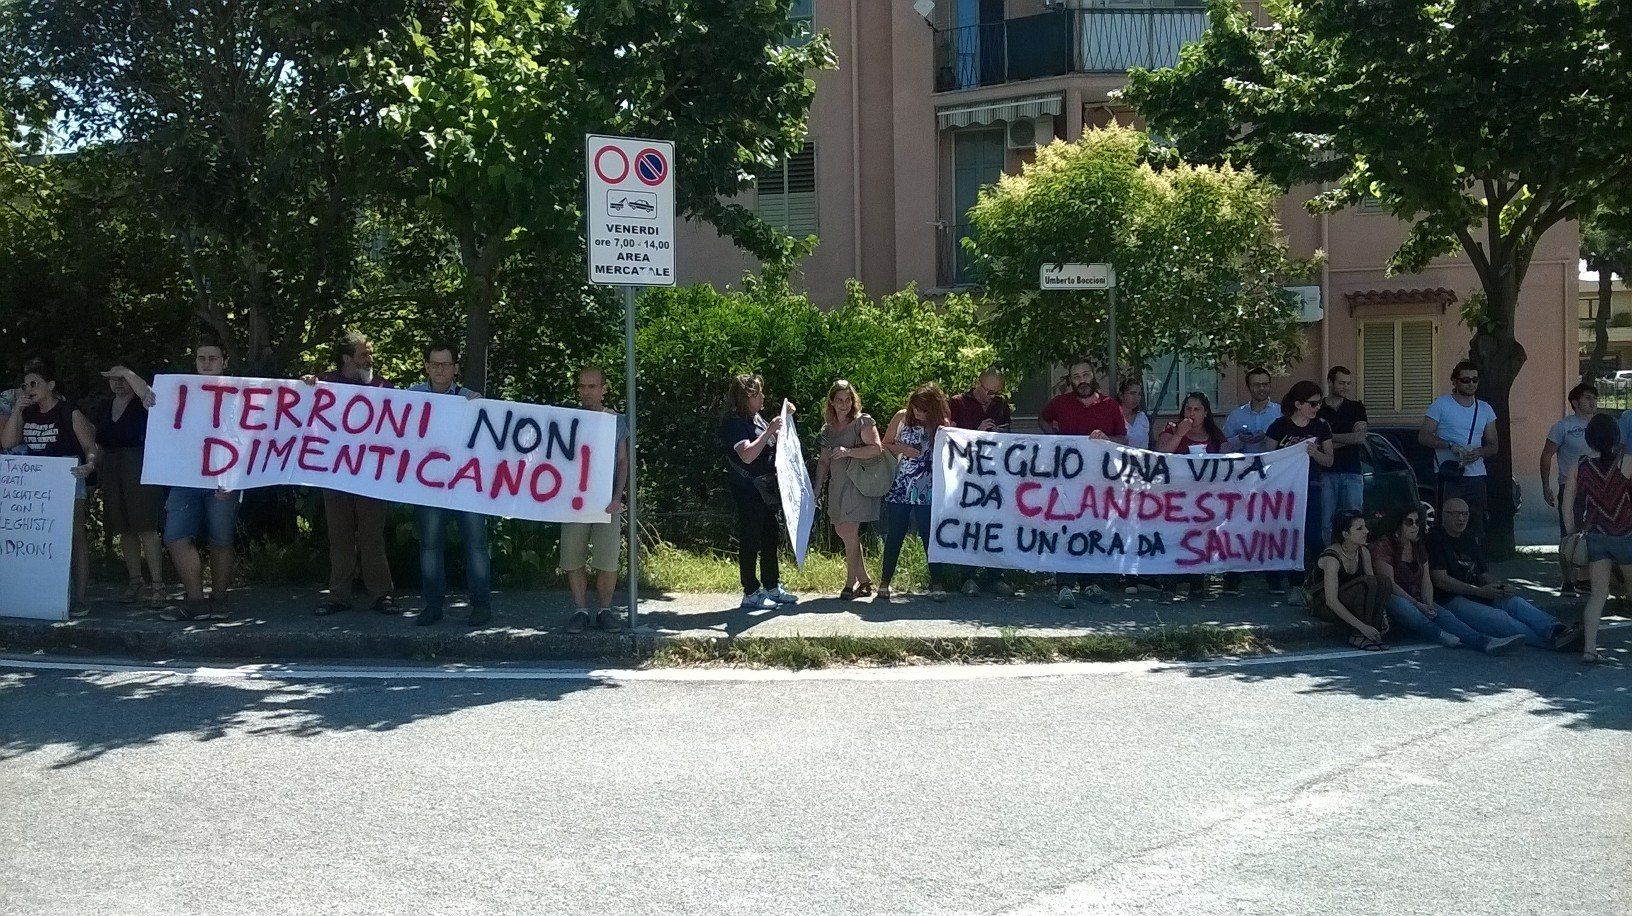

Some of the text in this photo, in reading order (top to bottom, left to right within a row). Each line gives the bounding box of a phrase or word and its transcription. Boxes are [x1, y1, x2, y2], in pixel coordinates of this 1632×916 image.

[606, 224, 659, 235] VENERDI
[614, 238, 635, 249] 7,00
[644, 240, 670, 251] 14,00
[617, 252, 650, 262] AREA
[1045, 276, 1105, 284] Umberto Boccioni
[173, 384, 579, 461] I TERRONI NON
[201, 437, 591, 511] DIMENTICANO!
[947, 438, 1267, 484] MEGLIO UNA VITA
[10, 502, 32, 512] CON
[960, 481, 1295, 524] DA CLANDESTINI
[935, 518, 1300, 567] CHE UN'ORA DA SALVINI
